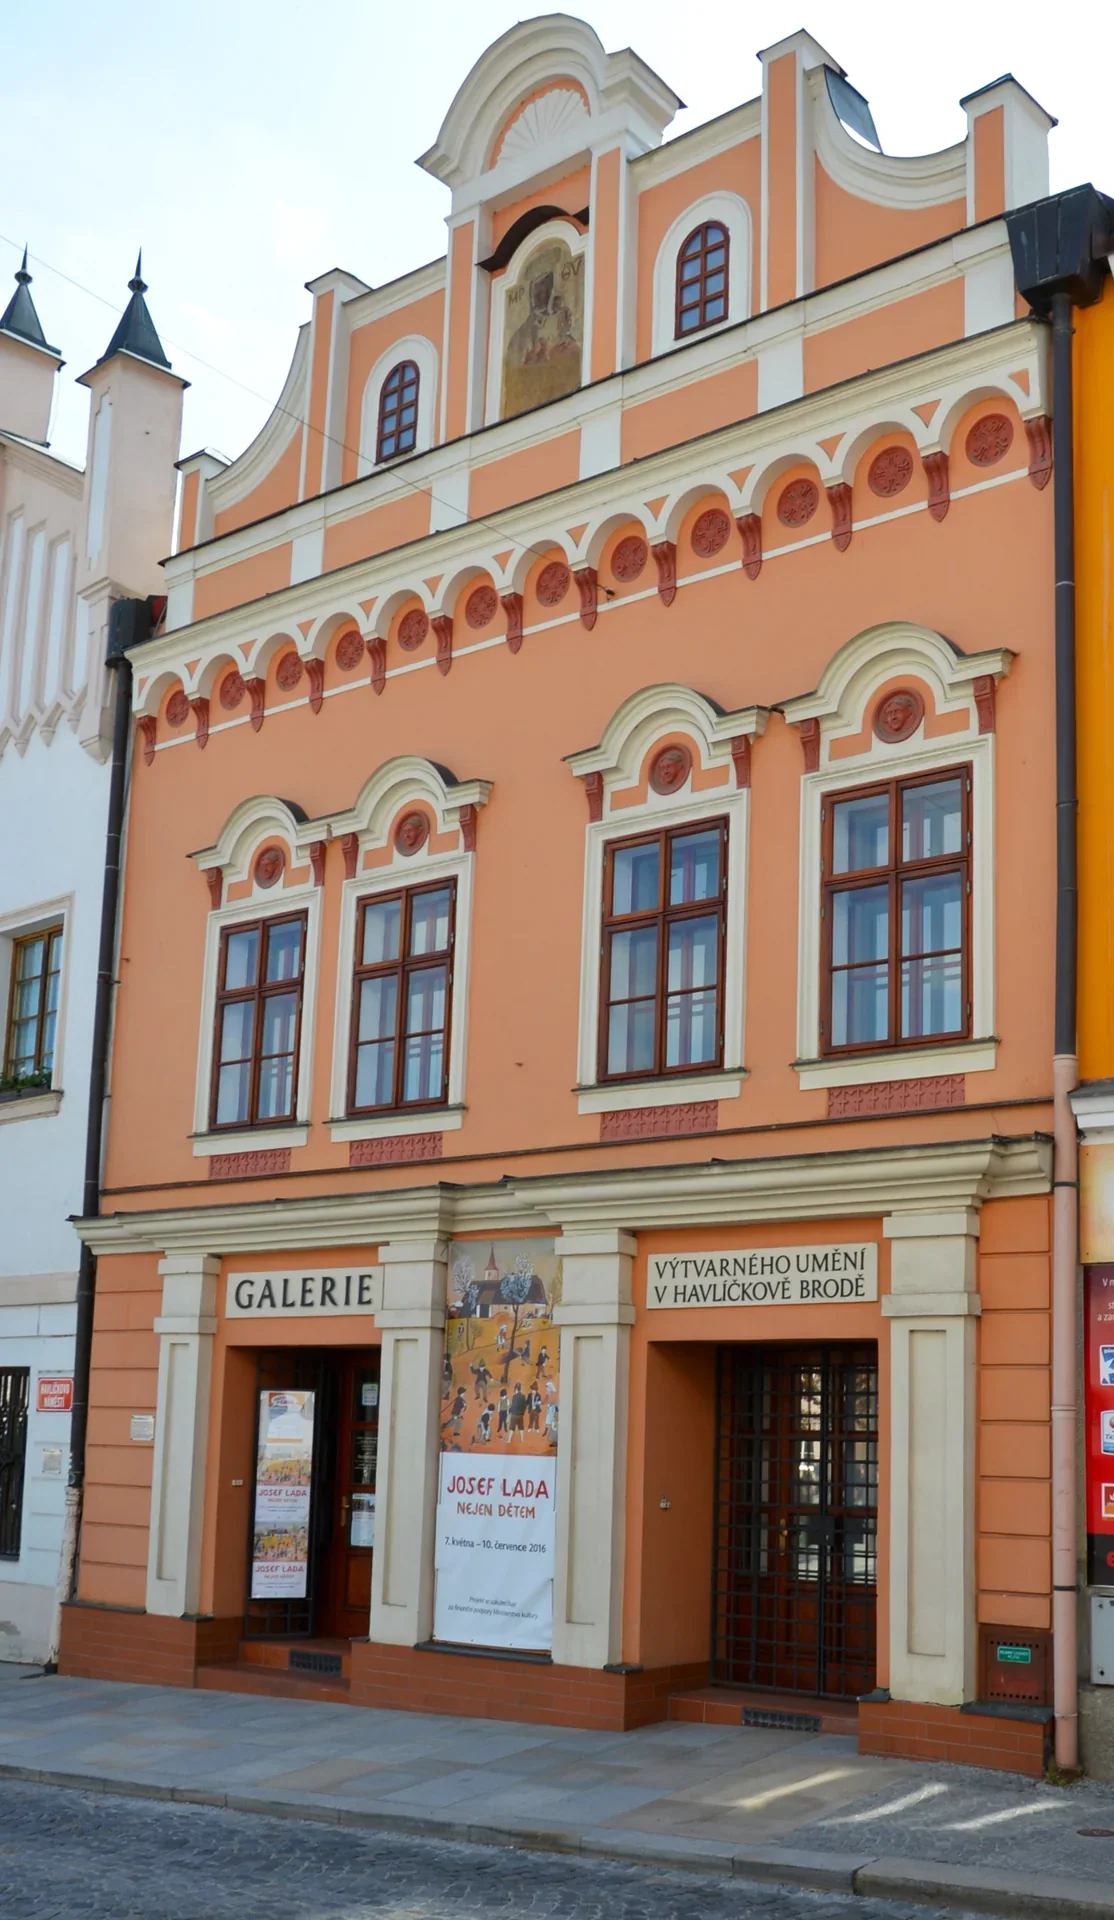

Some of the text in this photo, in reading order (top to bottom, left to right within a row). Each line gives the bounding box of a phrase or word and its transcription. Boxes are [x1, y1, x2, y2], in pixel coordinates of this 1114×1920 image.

[655, 1248, 867, 1279] VÝTVARNÉHO UMĚNÍ
[234, 1274, 372, 1309] GALERIE
[654, 1274, 866, 1304] V HAVLÍČKOVĚ BRODĚ
[258, 1489, 307, 1497] JOSEF LADA
[447, 1475, 549, 1499] JOSEF LADA
[457, 1502, 536, 1519] NEJEN DĚTEM
[451, 1537, 475, 1548] května
[494, 1541, 527, 1552] července
[529, 1543, 546, 1553] 2016
[255, 1565, 304, 1573] JOSEF LADA
